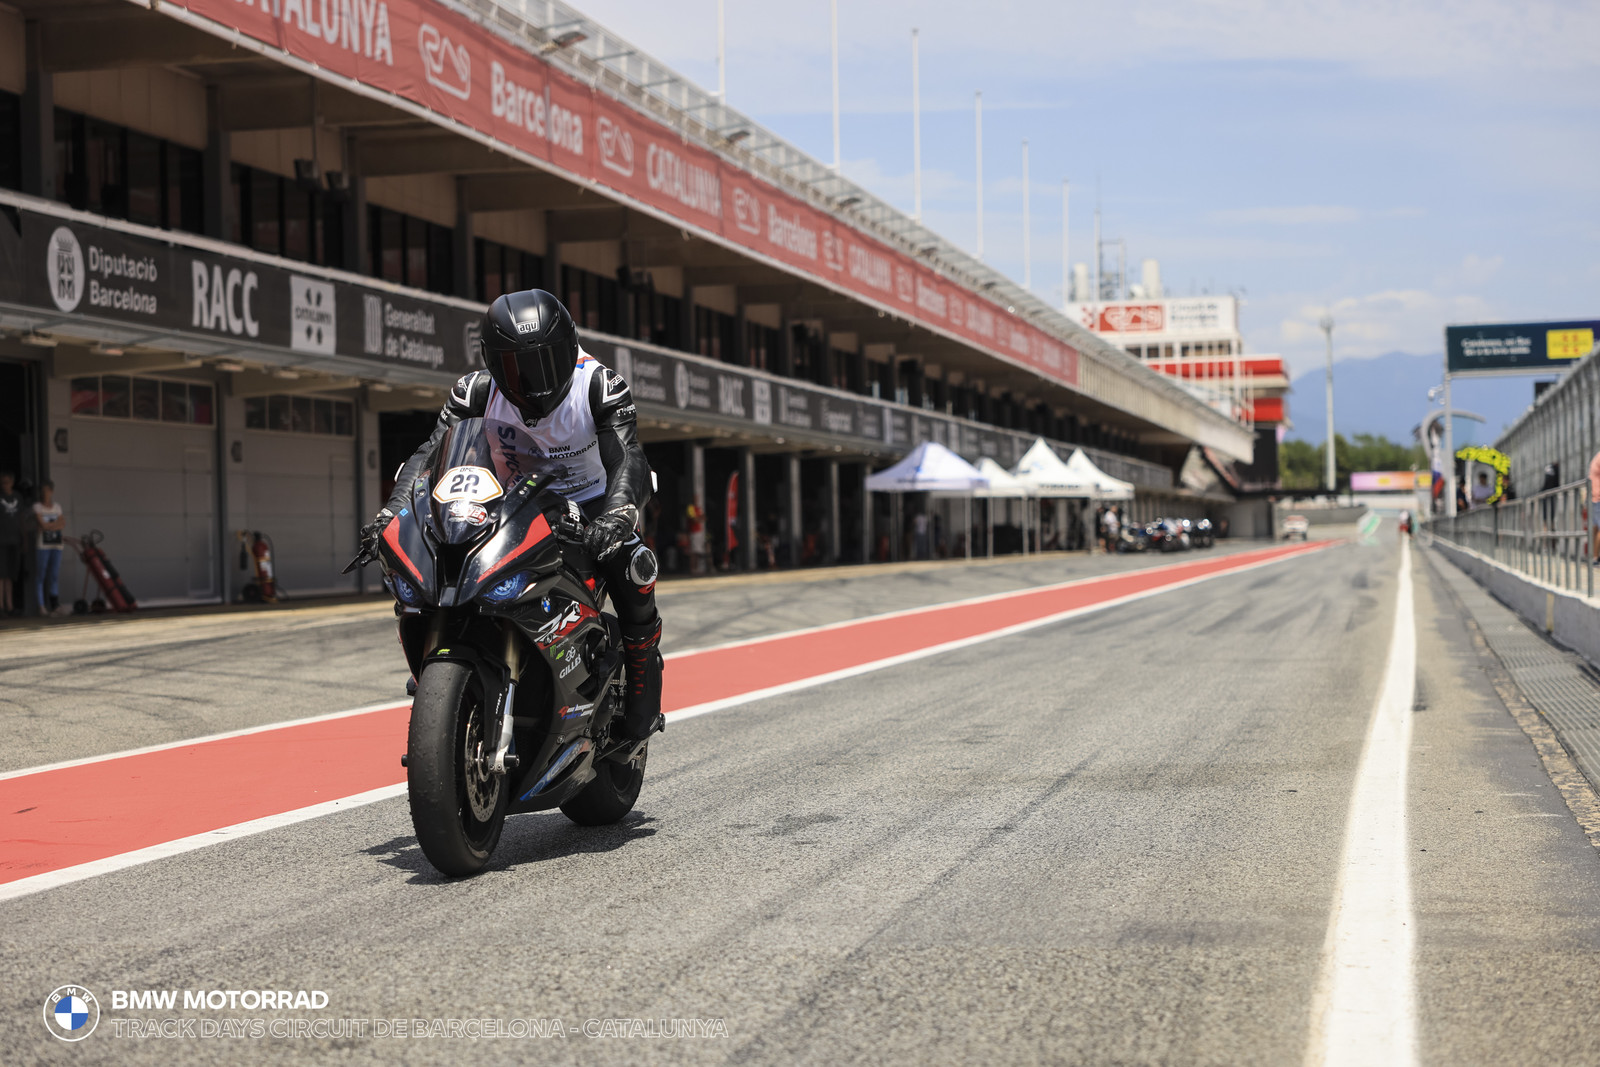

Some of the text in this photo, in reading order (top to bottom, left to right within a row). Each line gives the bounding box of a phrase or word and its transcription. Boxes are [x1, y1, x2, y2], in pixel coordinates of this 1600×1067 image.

[235, 0, 394, 66] ALUNYA
[490, 60, 584, 156] Barcelona
[89, 245, 158, 282] Diputació
[89, 279, 158, 315] Barcelona
[191, 259, 260, 338] RACC
[548, 444, 571, 454] BMW
[549, 440, 597, 460] MOTORRAD
[449, 473, 480, 494] 22
[559, 653, 582, 679] GILLES
